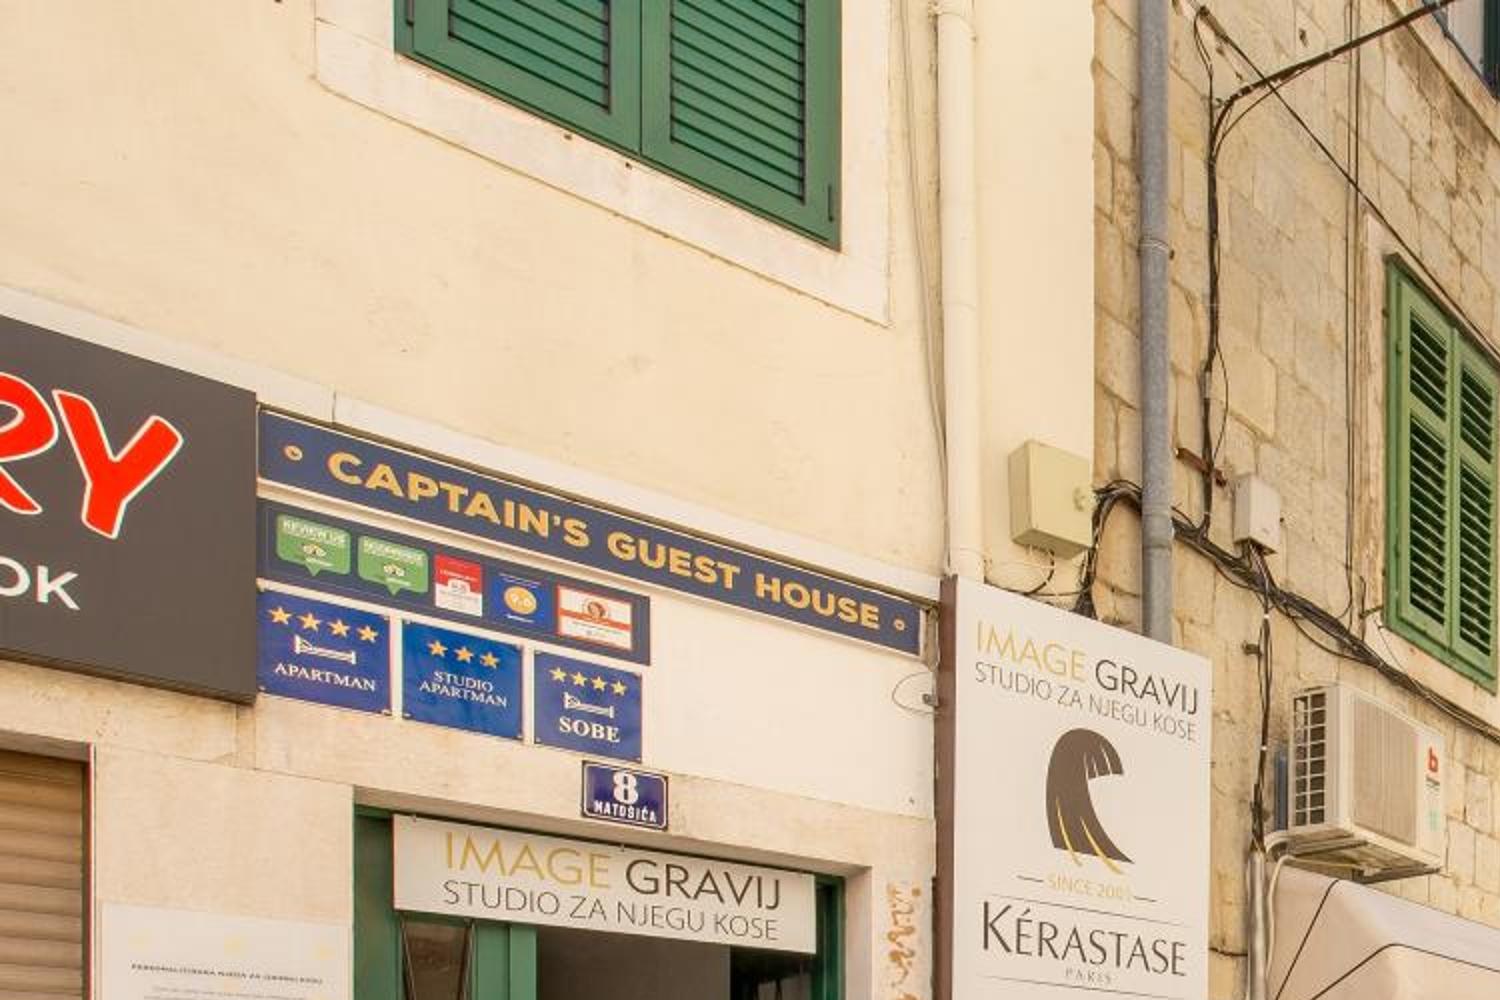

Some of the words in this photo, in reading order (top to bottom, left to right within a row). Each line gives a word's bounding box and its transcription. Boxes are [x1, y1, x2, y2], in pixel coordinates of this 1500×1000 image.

[328, 451, 590, 549] CAPTAIN'S
[607, 531, 740, 590] GUEST
[755, 574, 881, 630] HOUSE
[274, 661, 377, 693] APARTMAN
[432, 670, 494, 692] STUDIO
[976, 618, 1087, 682] IMAGE
[1094, 657, 1200, 716] GRAVIJ
[418, 681, 508, 708] APARTMAN
[974, 660, 1052, 701] STUDIO
[1056, 678, 1083, 712] ZA
[1088, 688, 1148, 731] NJEGU
[1151, 708, 1198, 743] KOSE
[558, 716, 622, 744] SOBE
[612, 768, 640, 805] 8
[591, 799, 657, 825] MATOŠIĆA
[444, 831, 611, 889] IMAGE
[625, 858, 781, 911] GRAVIJ
[1048, 872, 1094, 896] SINCE
[442, 880, 560, 917] STUDIO
[568, 894, 608, 923] ZA
[616, 899, 706, 934] NJEGU
[713, 913, 780, 942] KOSE
[981, 899, 1188, 977] KÉRASTASE
[1065, 968, 1114, 985] PARIS
